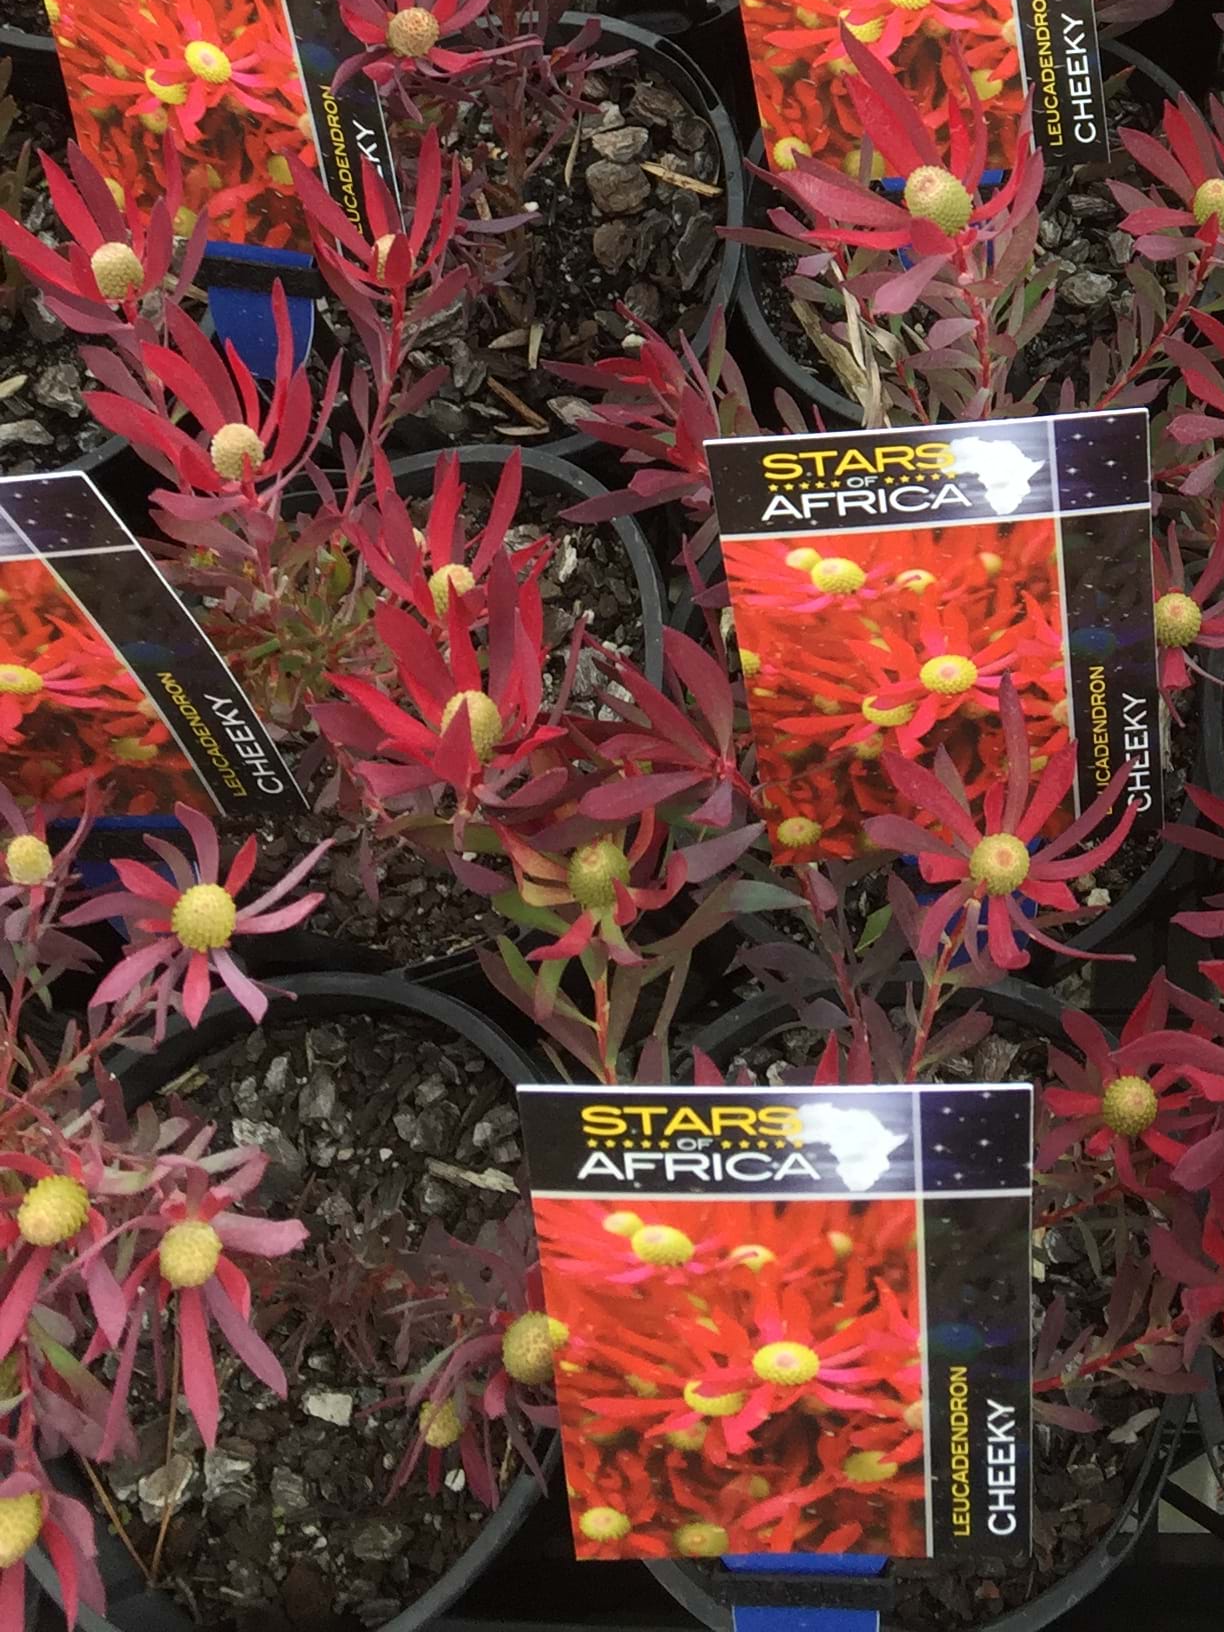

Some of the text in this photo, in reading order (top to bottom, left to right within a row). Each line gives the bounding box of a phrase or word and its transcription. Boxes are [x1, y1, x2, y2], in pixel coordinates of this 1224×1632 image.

[1061, 12, 1097, 144] CHEEKY
[319, 85, 363, 235] EUCADENDRON
[762, 443, 954, 480] STARS
[762, 484, 971, 521] AFRICA
[847, 476, 878, 488] OF
[157, 672, 247, 797] LEUCADENDRON
[204, 694, 284, 794] CHEEKY
[1089, 666, 1112, 815] CADENDRON
[1123, 692, 1152, 812] CHEEKY
[578, 1152, 819, 1181] AFRICA
[581, 1105, 802, 1136] STARS
[677, 1138, 713, 1151] OF
[951, 1365, 971, 1536] LEUCADENDRON
[987, 1398, 1017, 1535] CHEEKY
